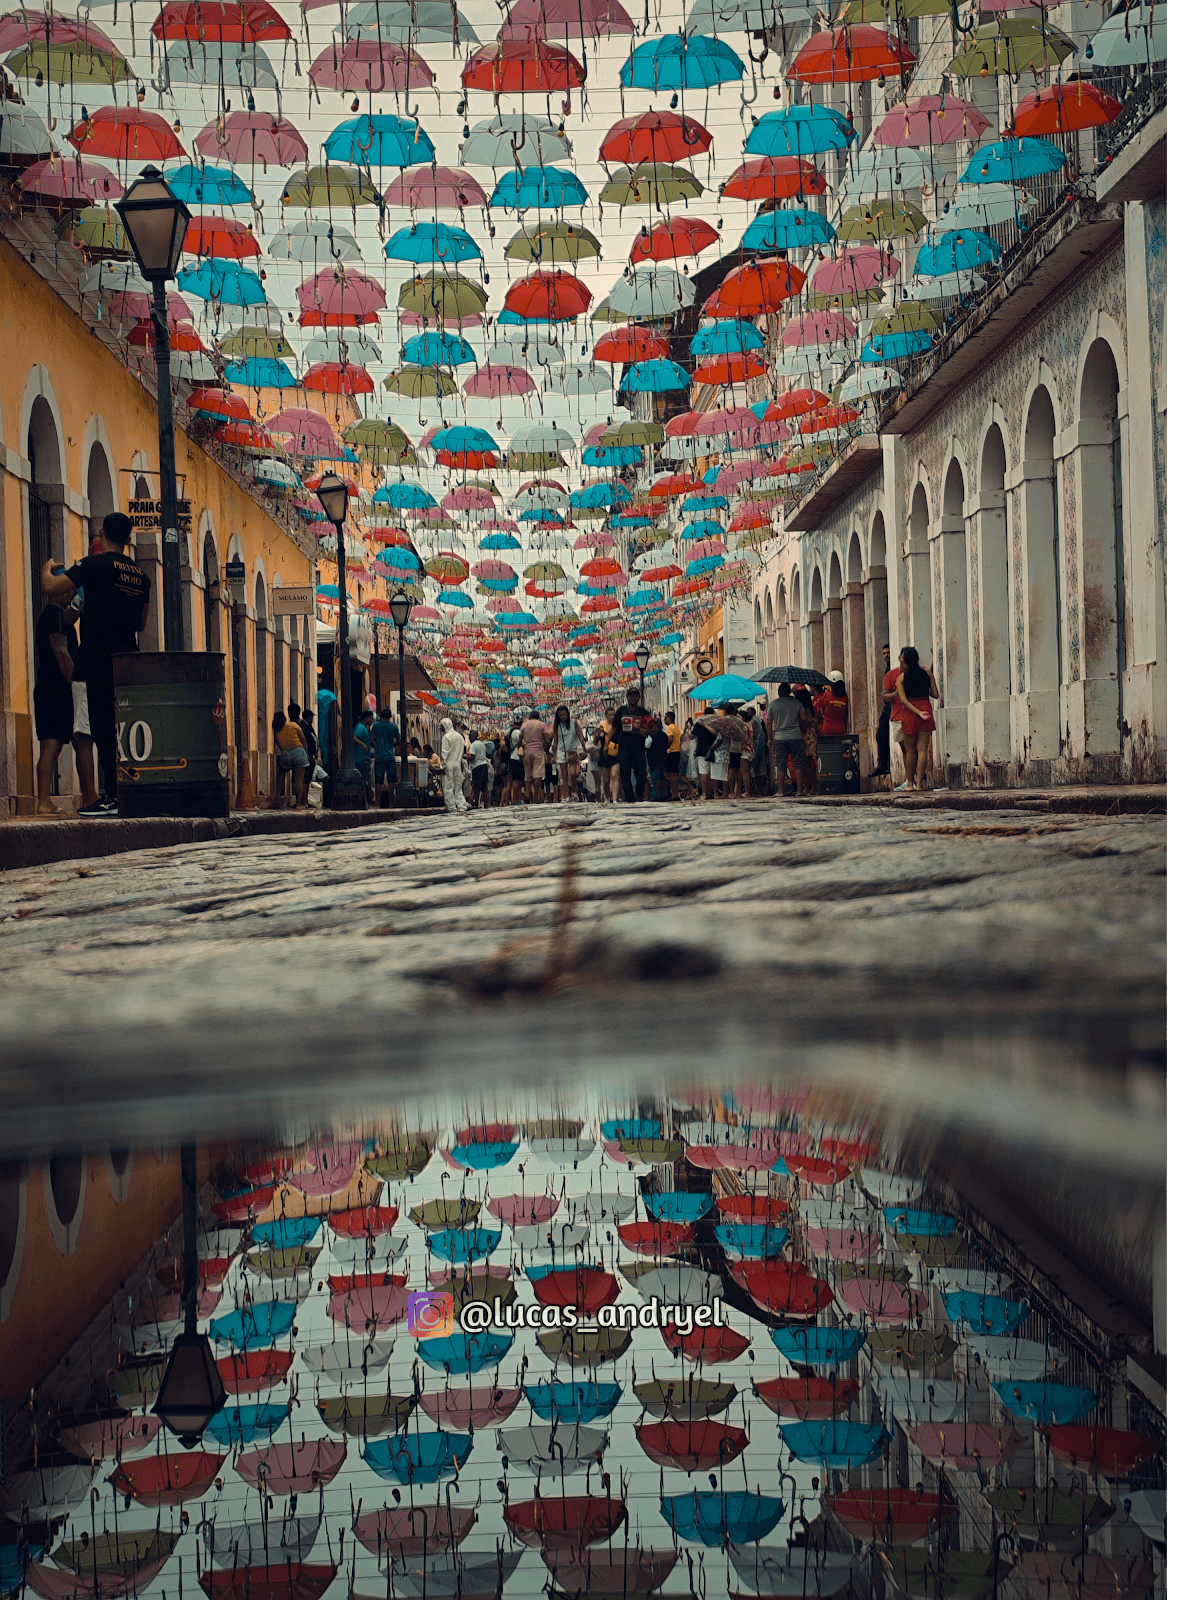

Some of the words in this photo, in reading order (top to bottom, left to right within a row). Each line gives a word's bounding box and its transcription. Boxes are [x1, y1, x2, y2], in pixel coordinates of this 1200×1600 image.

[129, 501, 154, 513] PRAIA
[156, 501, 191, 513] GDE
[119, 573, 142, 585] APOIO
